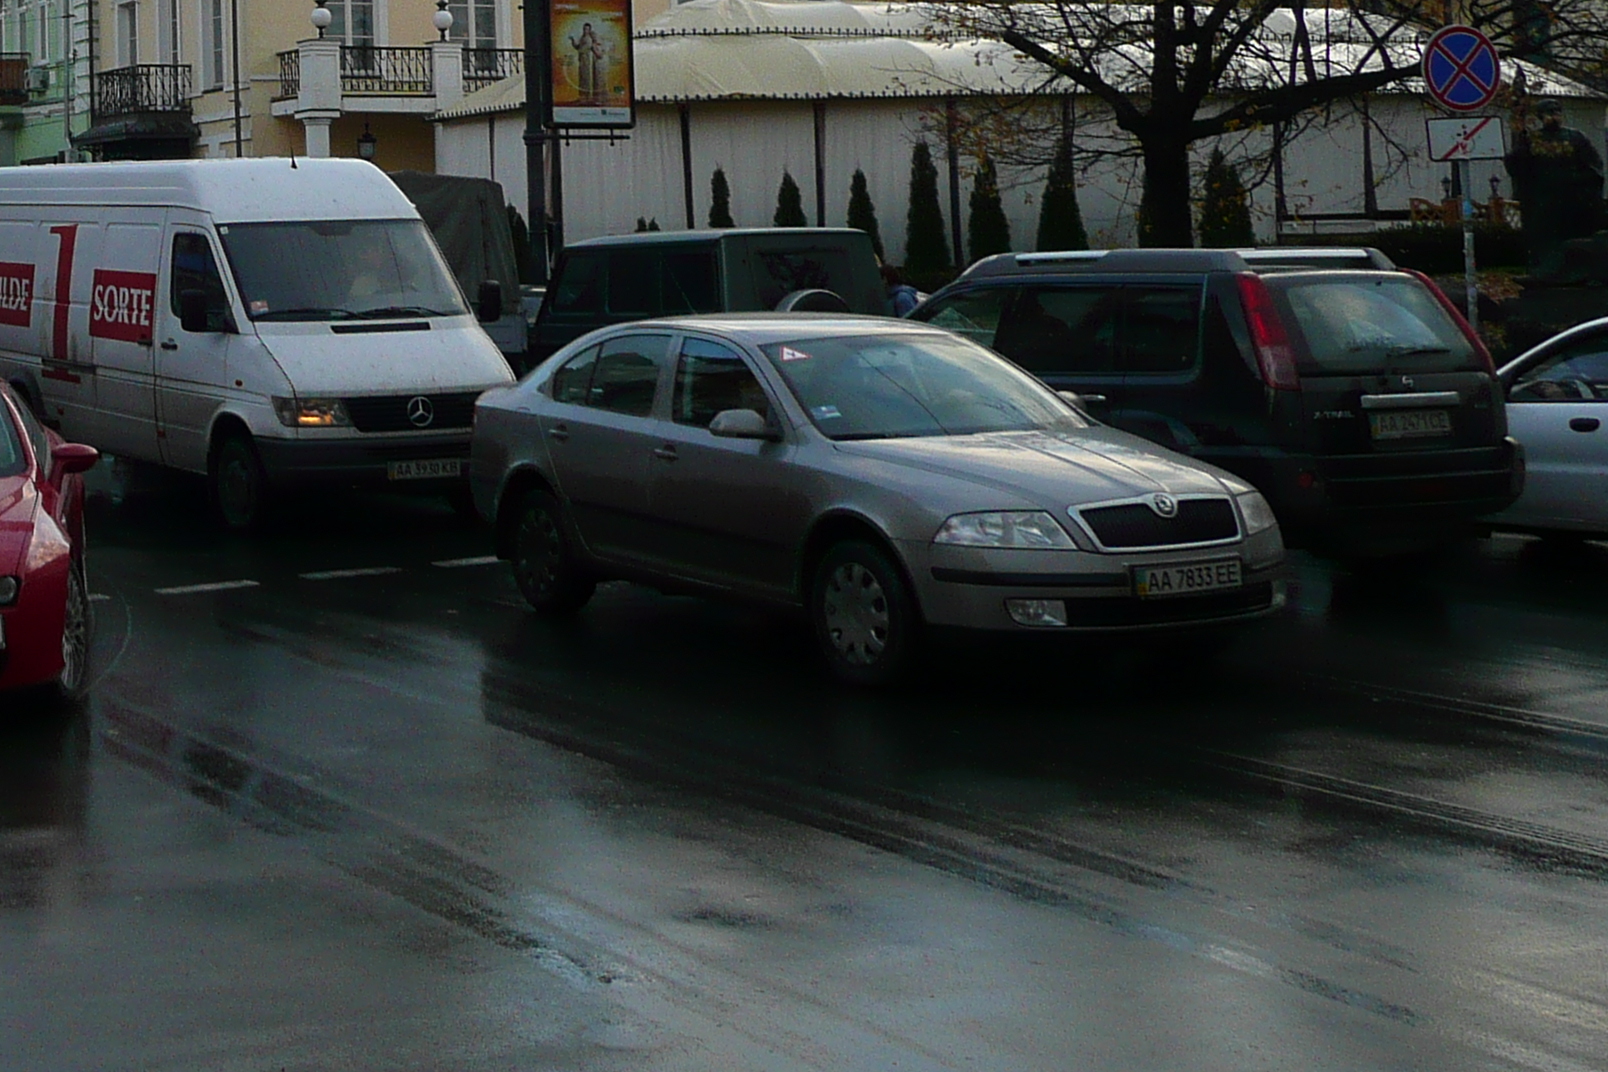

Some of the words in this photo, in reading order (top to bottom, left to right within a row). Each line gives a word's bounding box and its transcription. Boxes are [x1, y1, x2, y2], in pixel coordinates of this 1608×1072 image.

[94, 284, 152, 327] SORTE
[1148, 570, 1173, 593] AA
[1175, 566, 1214, 589] 7833
[1215, 563, 1239, 584] EE
